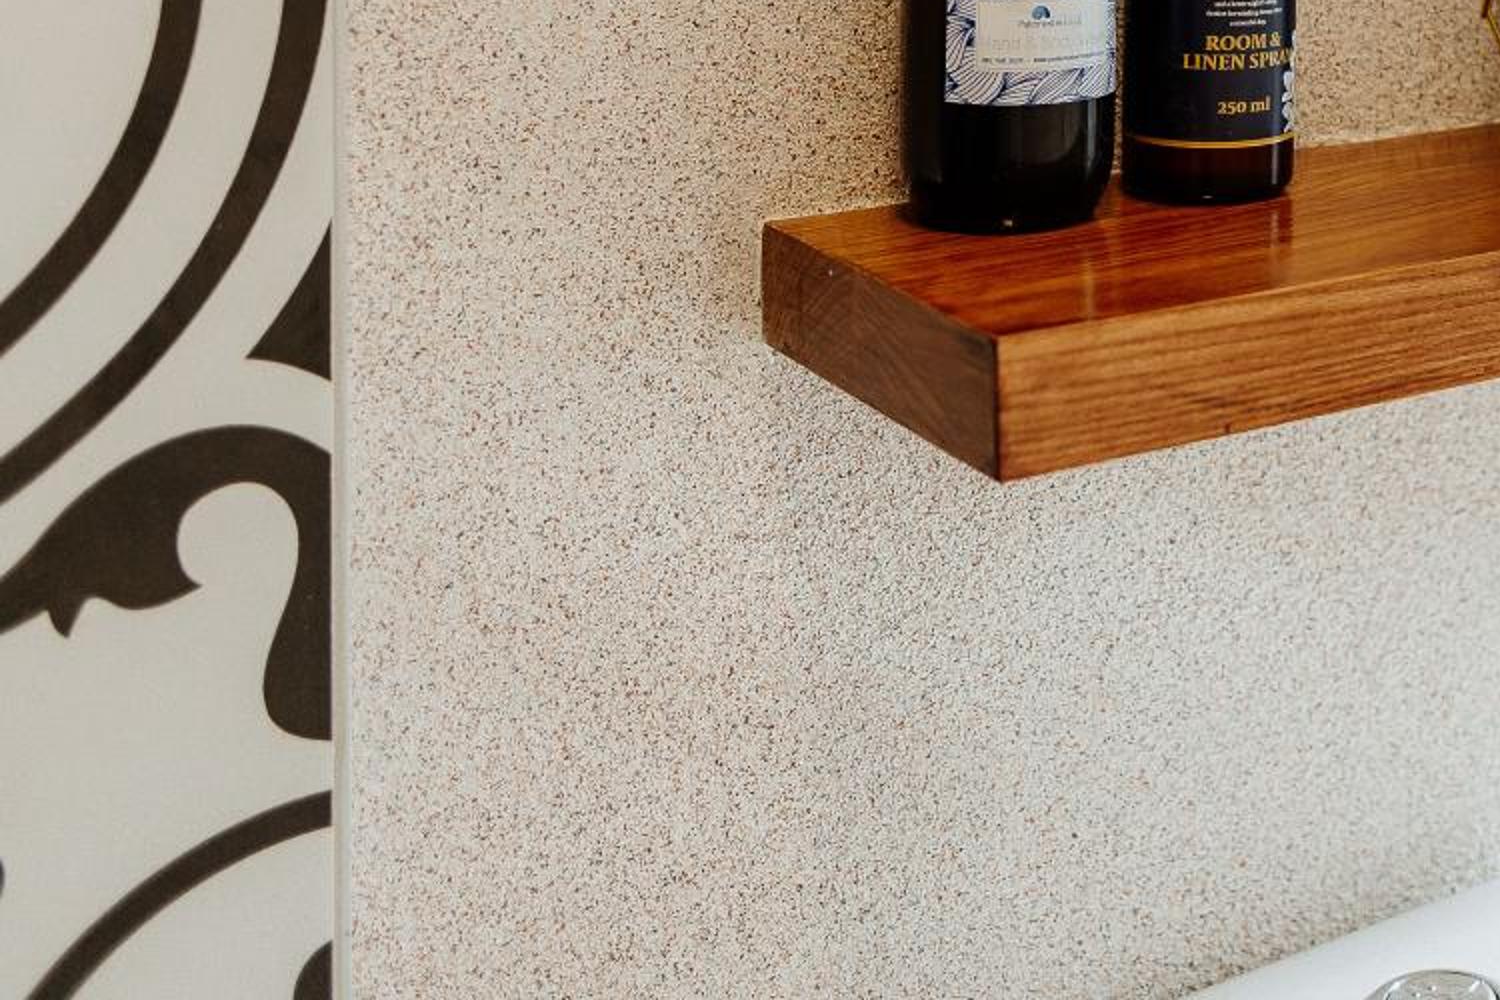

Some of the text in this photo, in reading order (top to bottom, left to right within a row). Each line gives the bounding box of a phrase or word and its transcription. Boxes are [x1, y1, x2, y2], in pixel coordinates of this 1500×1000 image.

[1205, 31, 1281, 50] ROOM &
[1183, 53, 1246, 71] LINEN
[1216, 95, 1271, 115] 250 ml
